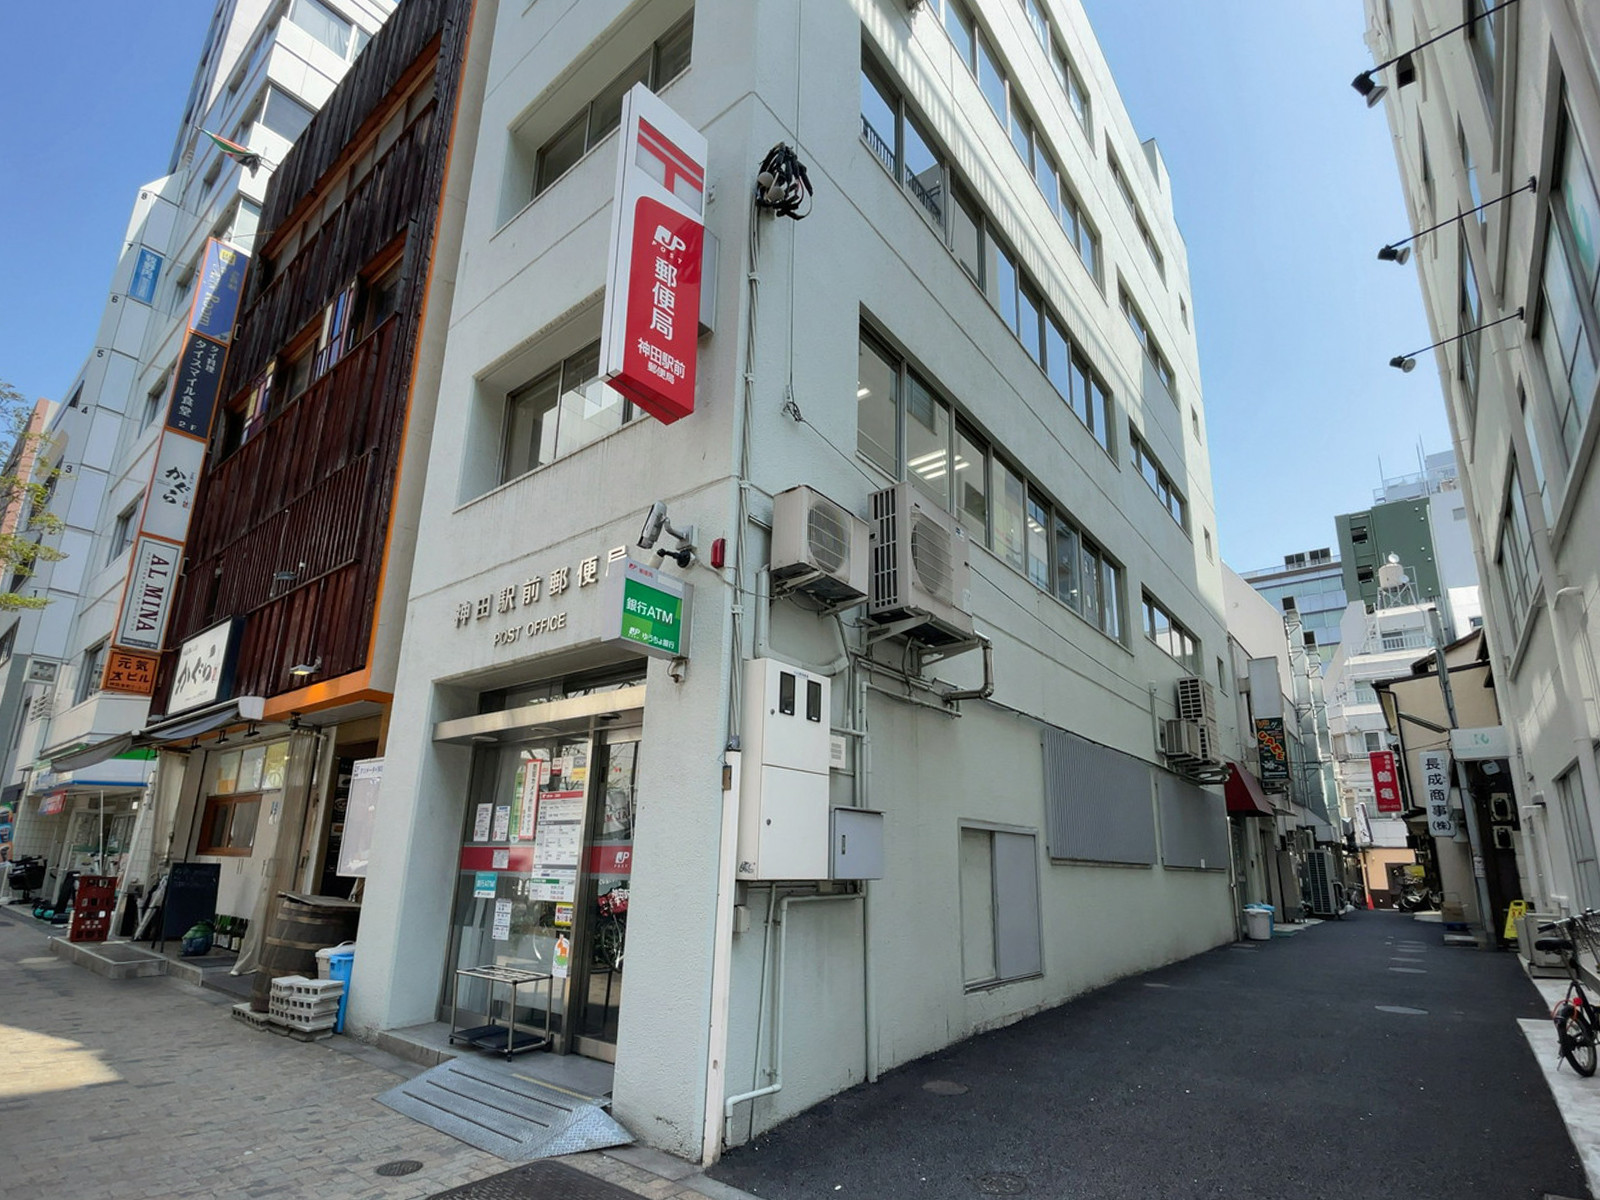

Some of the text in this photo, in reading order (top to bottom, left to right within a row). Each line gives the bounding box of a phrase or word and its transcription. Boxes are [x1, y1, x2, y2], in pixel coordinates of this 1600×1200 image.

[141, 192, 148, 200] 8
[127, 243, 133, 251] 7
[651, 240, 683, 264] POST
[111, 295, 118, 303] 6
[649, 255, 677, 341] 郵便局
[96, 349, 104, 358] 5
[205, 345, 219, 374] タイ料理
[637, 337, 686, 379] 神田駅前
[178, 339, 207, 418] タイスマイル食堂
[647, 361, 675, 385] 郵便局
[81, 406, 88, 414] 4
[65, 465, 72, 473] 3
[148, 554, 170, 580] AL
[136, 583, 165, 632] MINA
[626, 597, 673, 625] 銀行ATM
[493, 612, 567, 648] POST OFFICE
[642, 631, 675, 650] ゆうちょ銀行
[118, 656, 148, 672] 元気
